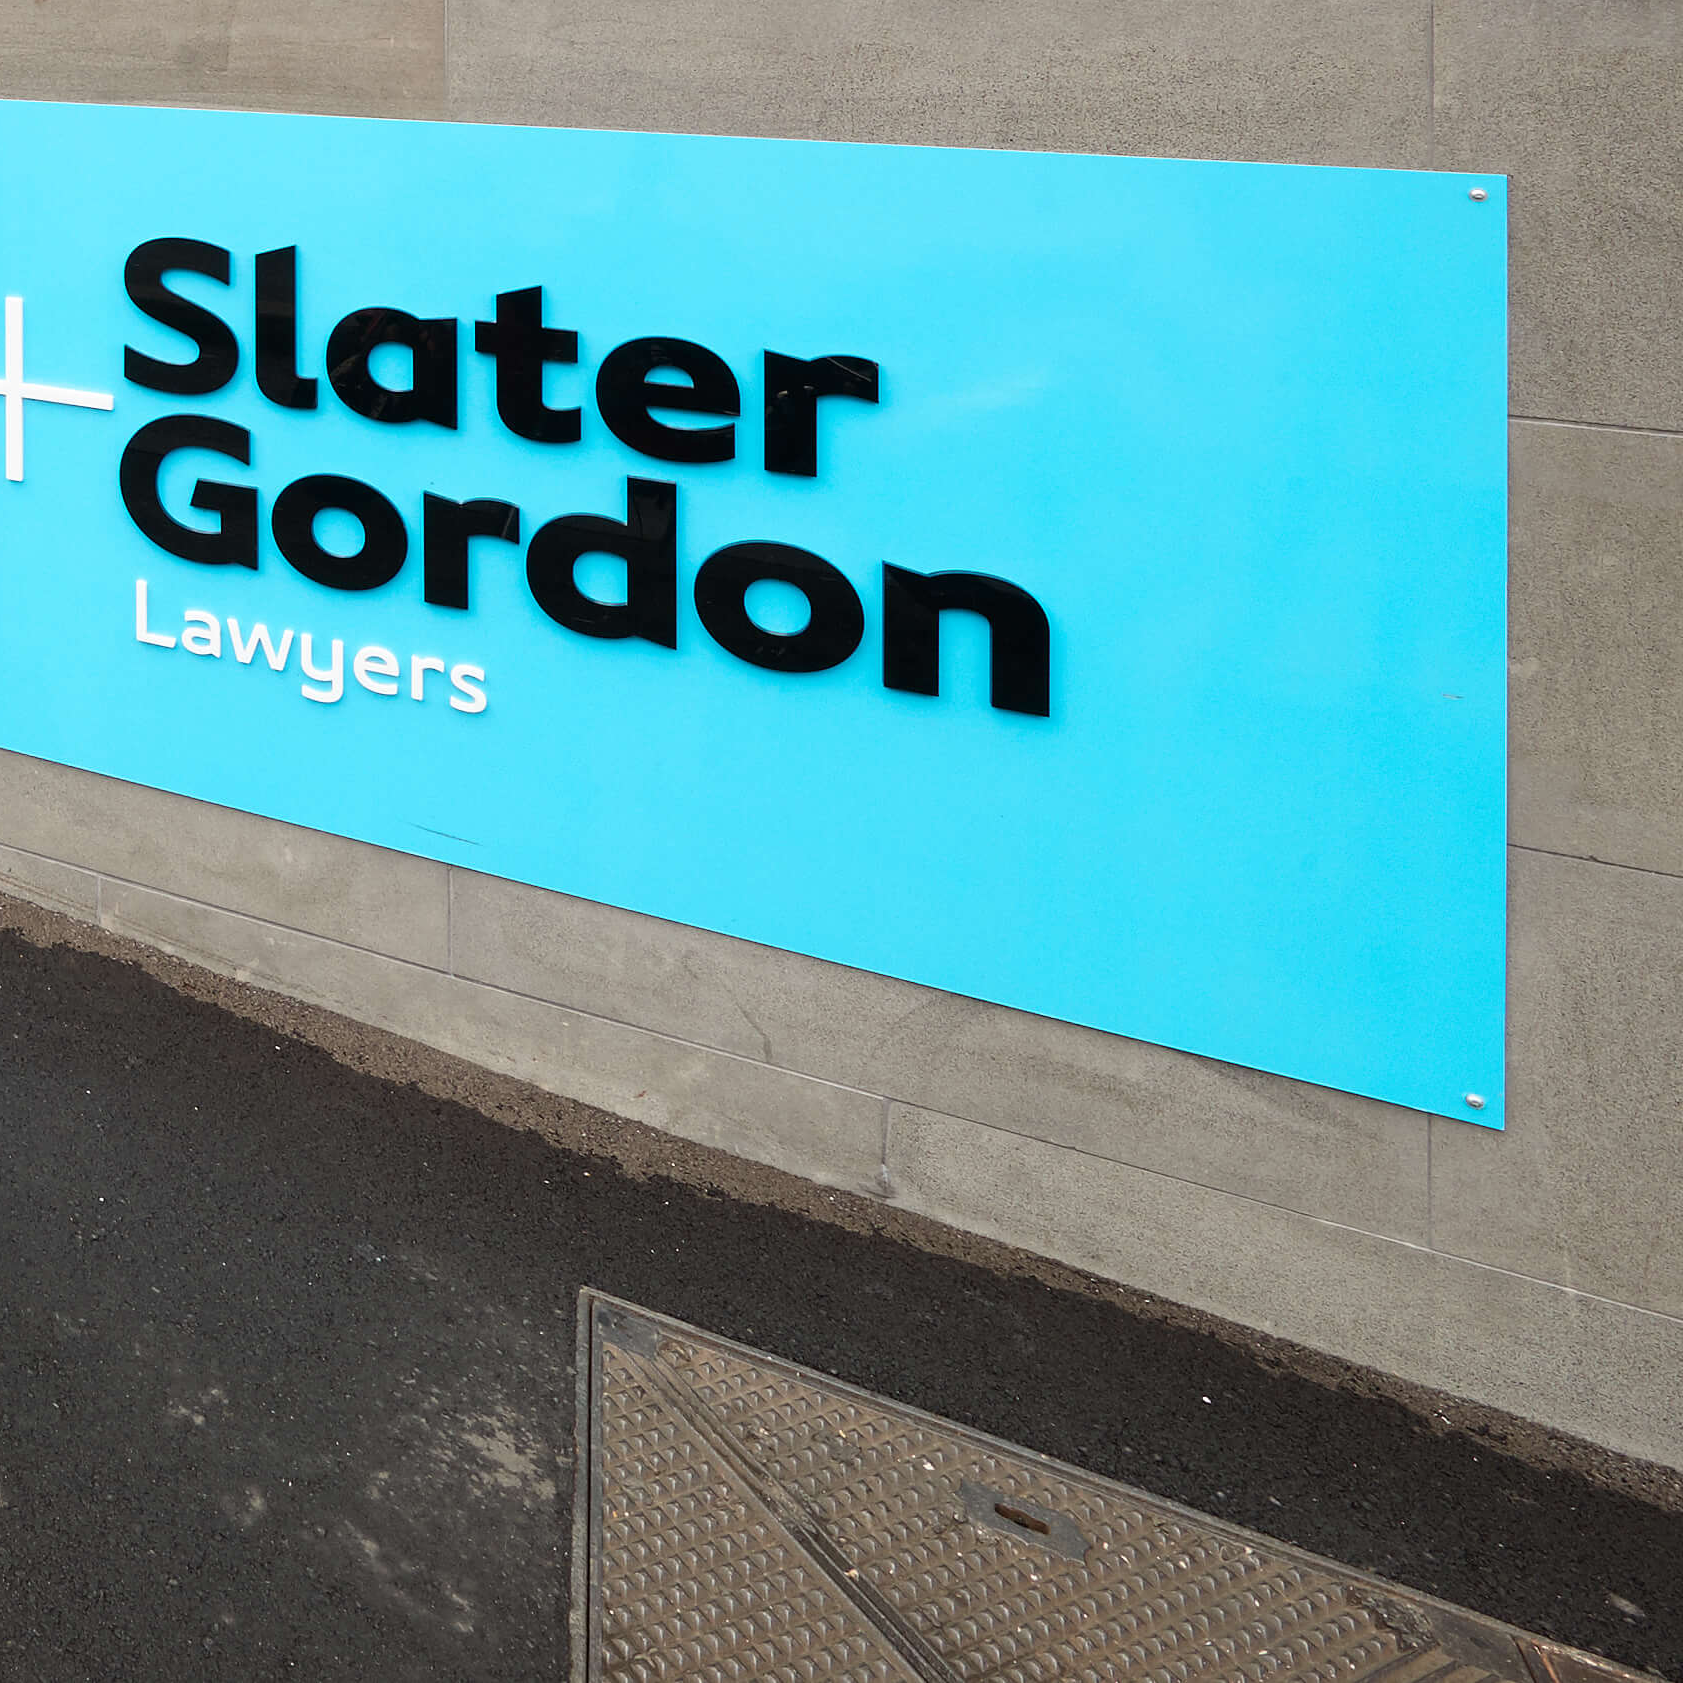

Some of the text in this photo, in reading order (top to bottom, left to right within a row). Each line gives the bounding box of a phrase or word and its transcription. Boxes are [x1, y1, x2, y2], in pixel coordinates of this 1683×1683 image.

[123, 237, 881, 478] Slater
[119, 414, 1052, 718] Gordon
[135, 579, 488, 714] Lawyers
